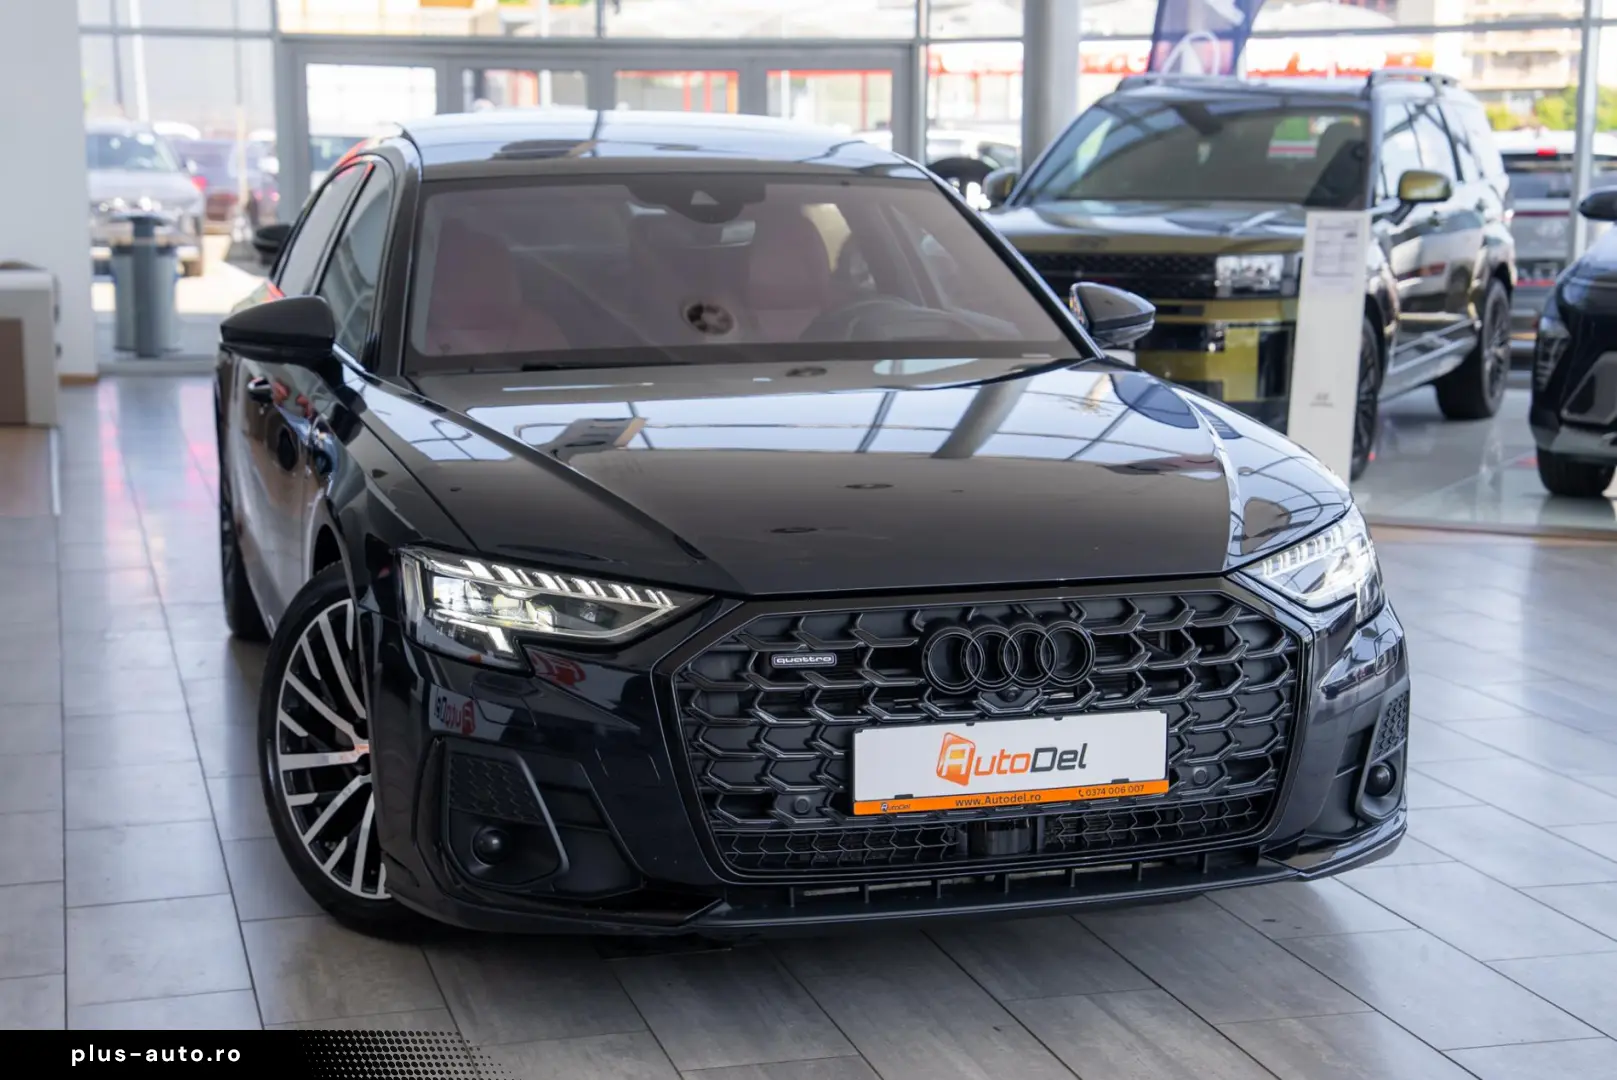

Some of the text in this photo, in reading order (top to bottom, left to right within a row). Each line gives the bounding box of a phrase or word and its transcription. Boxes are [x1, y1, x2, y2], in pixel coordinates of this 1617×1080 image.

[776, 656, 832, 665] quattro
[936, 732, 1088, 786] AutoDel
[1085, 784, 1145, 797] 0374 006 007
[955, 792, 1041, 807] www.Autodel.ro
